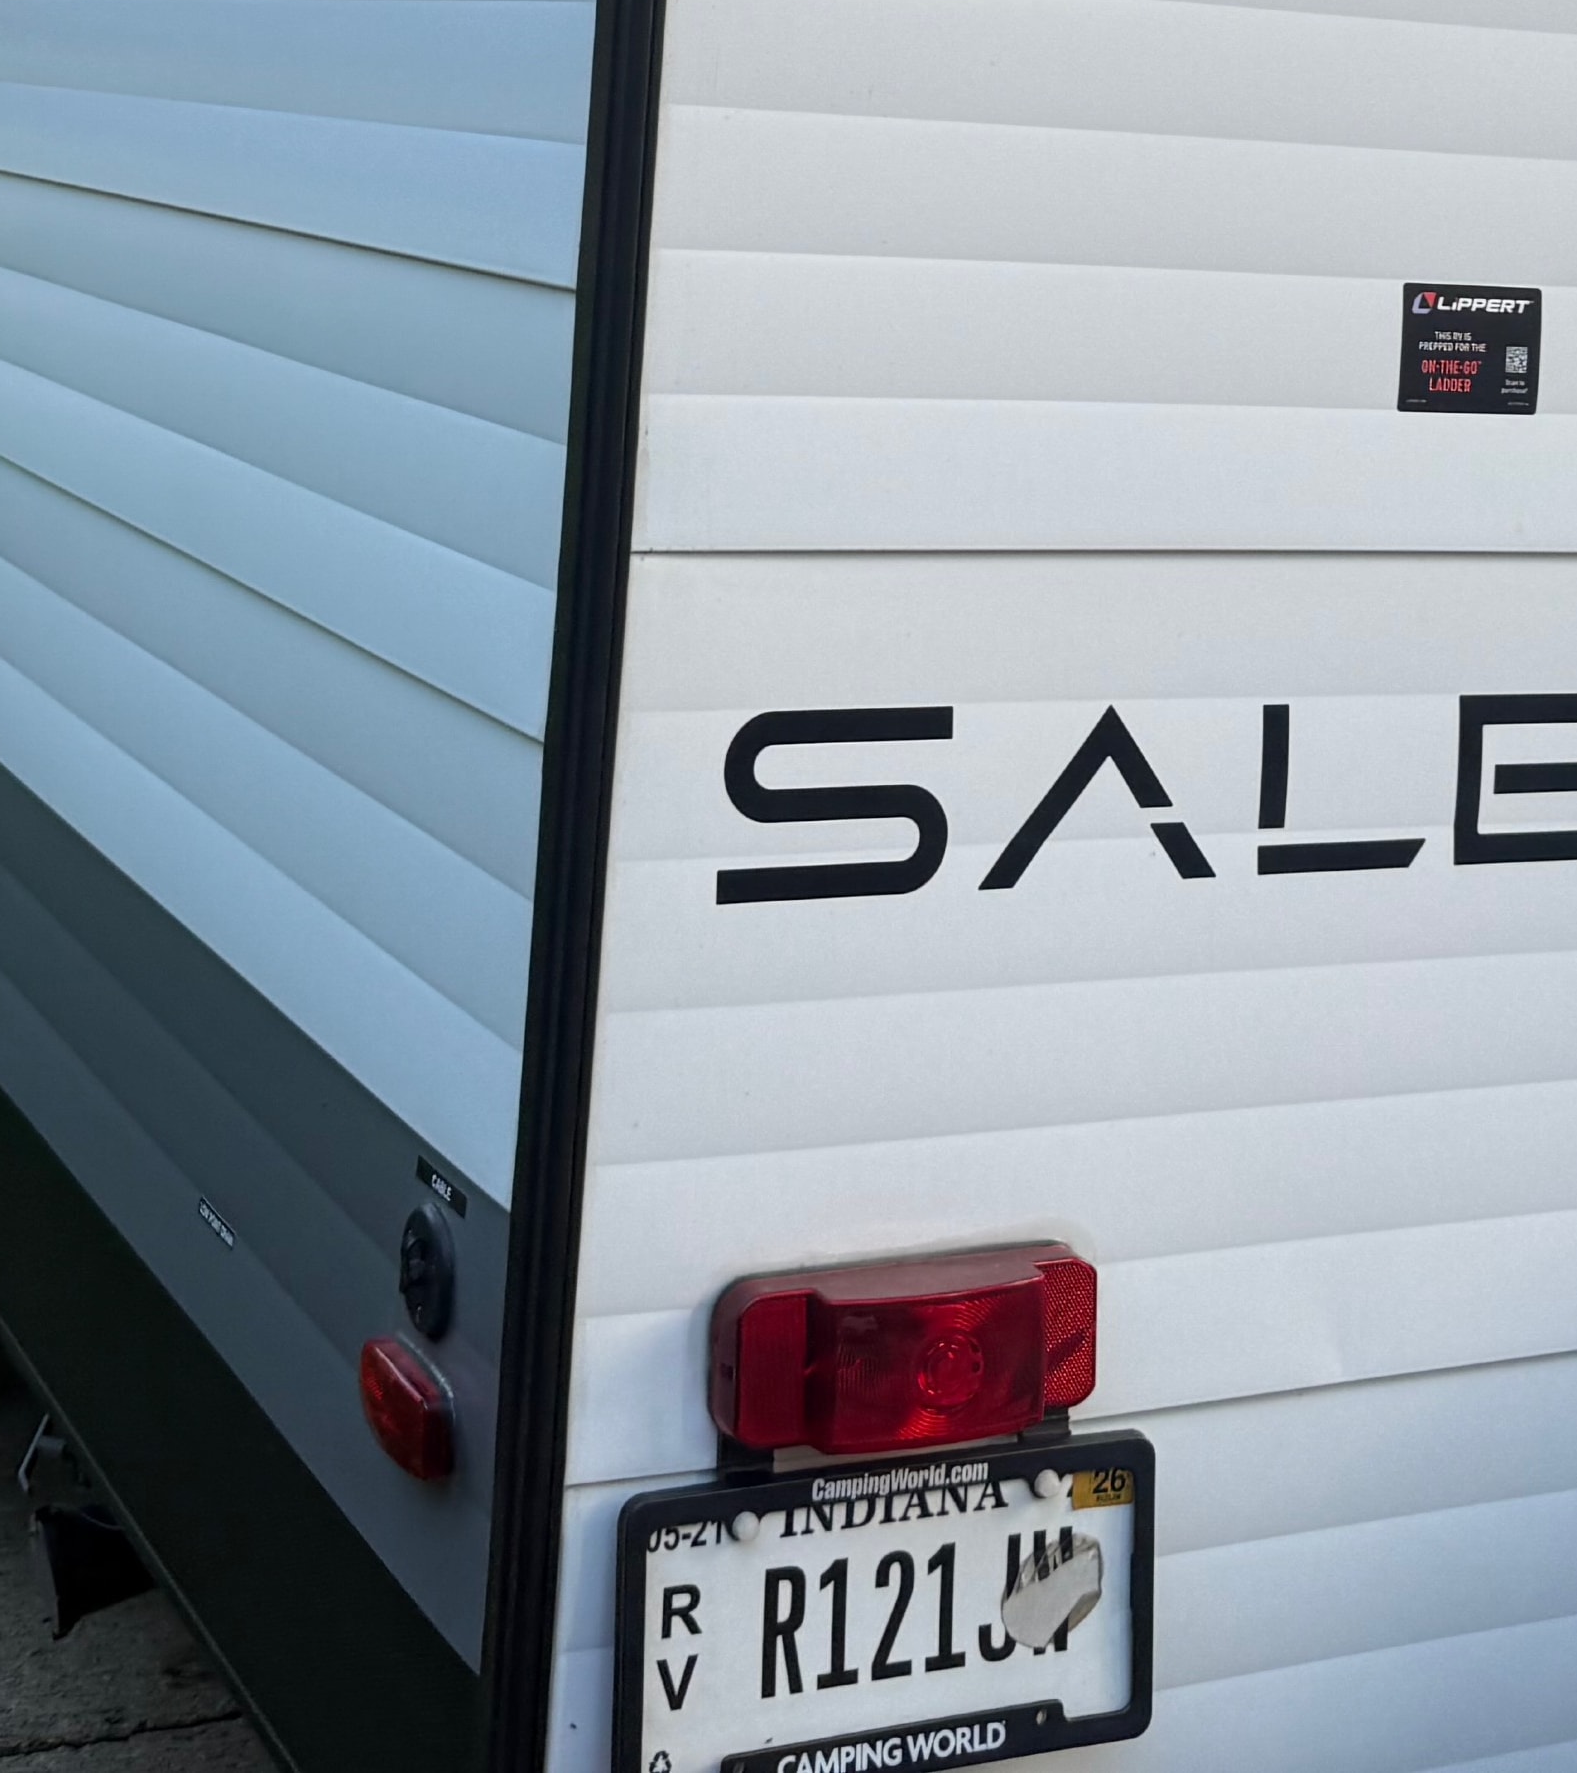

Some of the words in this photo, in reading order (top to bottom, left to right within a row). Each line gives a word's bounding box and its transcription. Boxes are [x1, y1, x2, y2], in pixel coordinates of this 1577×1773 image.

[1434, 330, 1452, 341] THIS
[1454, 342, 1470, 352] FOR
[1471, 343, 1487, 353] THE
[1428, 377, 1472, 393] LADDER
[811, 1461, 988, 1502] CampingWorld.com
[1092, 1468, 1127, 1494] 26
[779, 1479, 1010, 1538] INDIANA
[776, 1730, 903, 1773] CAMPING
[908, 1720, 1007, 1762] WORLD
